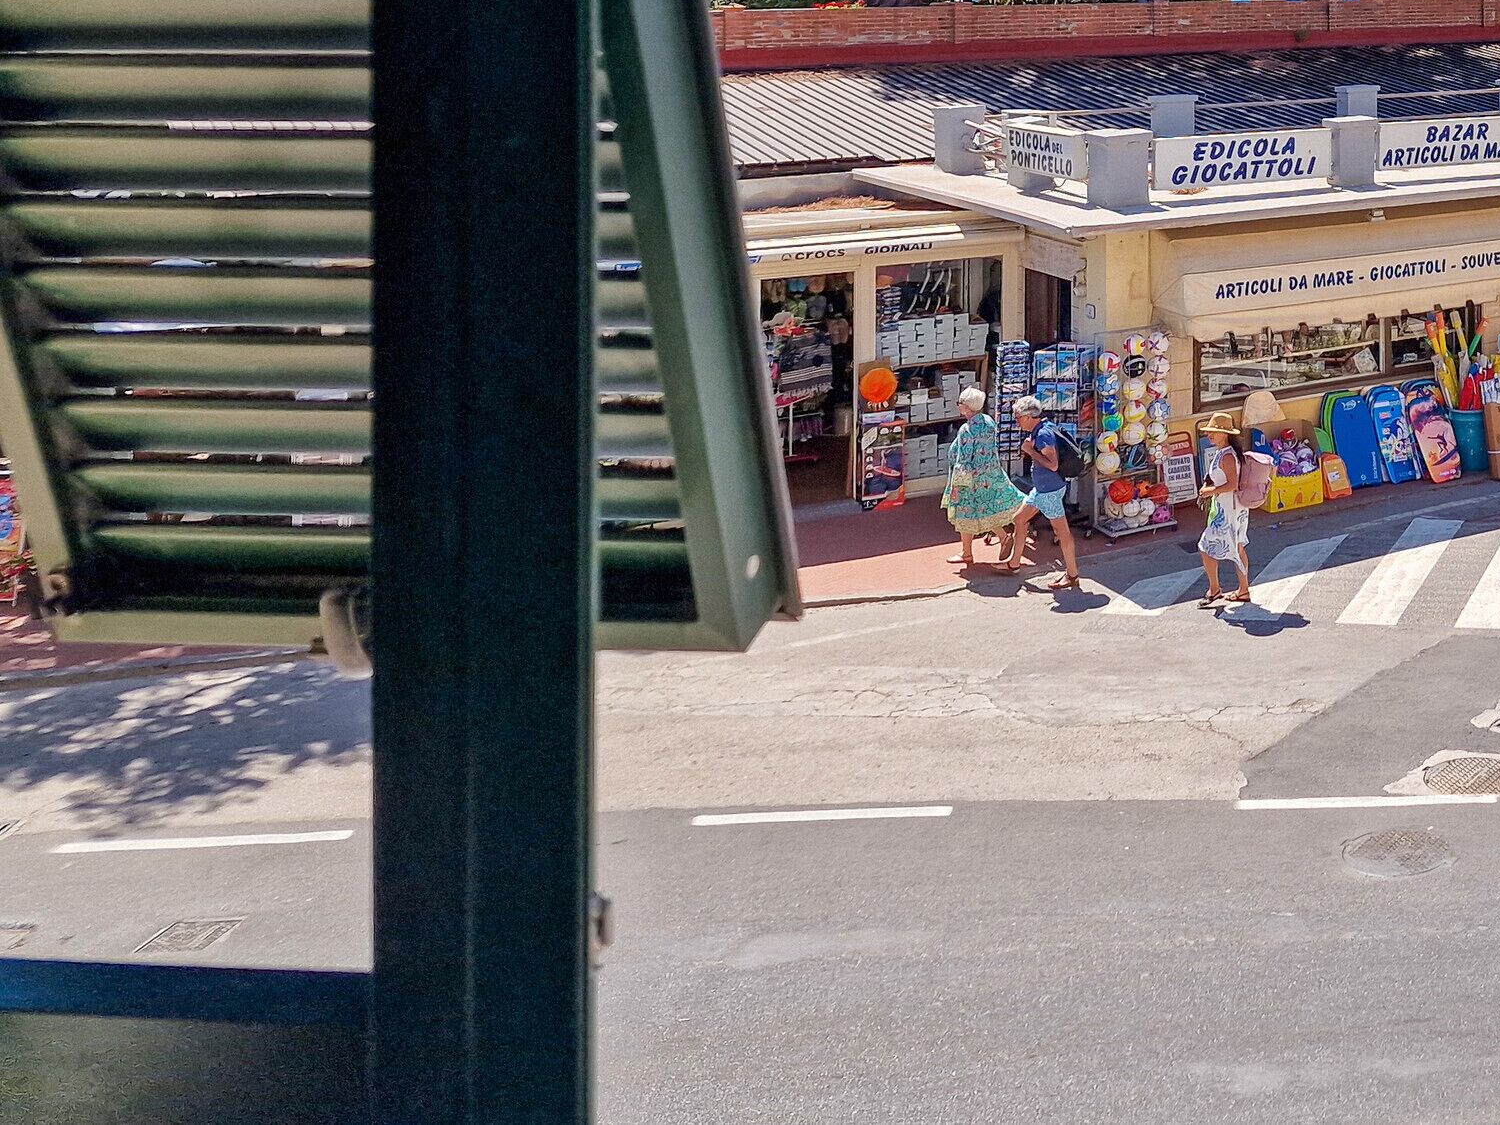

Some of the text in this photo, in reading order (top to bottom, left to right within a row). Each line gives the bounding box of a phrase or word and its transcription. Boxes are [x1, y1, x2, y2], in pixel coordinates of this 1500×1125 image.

[1008, 129, 1063, 155] EDICOLA DEL
[1425, 122, 1489, 143] BAZAR
[1192, 136, 1296, 162] EDICOLA
[1382, 143, 1456, 168] ARTICOLI
[1459, 143, 1480, 164] DA
[1010, 149, 1072, 177] PONTICELLO
[1171, 156, 1317, 186] GIOCATTOLI
[794, 247, 846, 261] crocs
[864, 242, 933, 255] GIORNALI
[1215, 279, 1283, 300] ARTICOLI
[1288, 276, 1308, 291] DA
[1312, 270, 1354, 290] MARE
[1370, 260, 1446, 282] GIOCATTOLI
